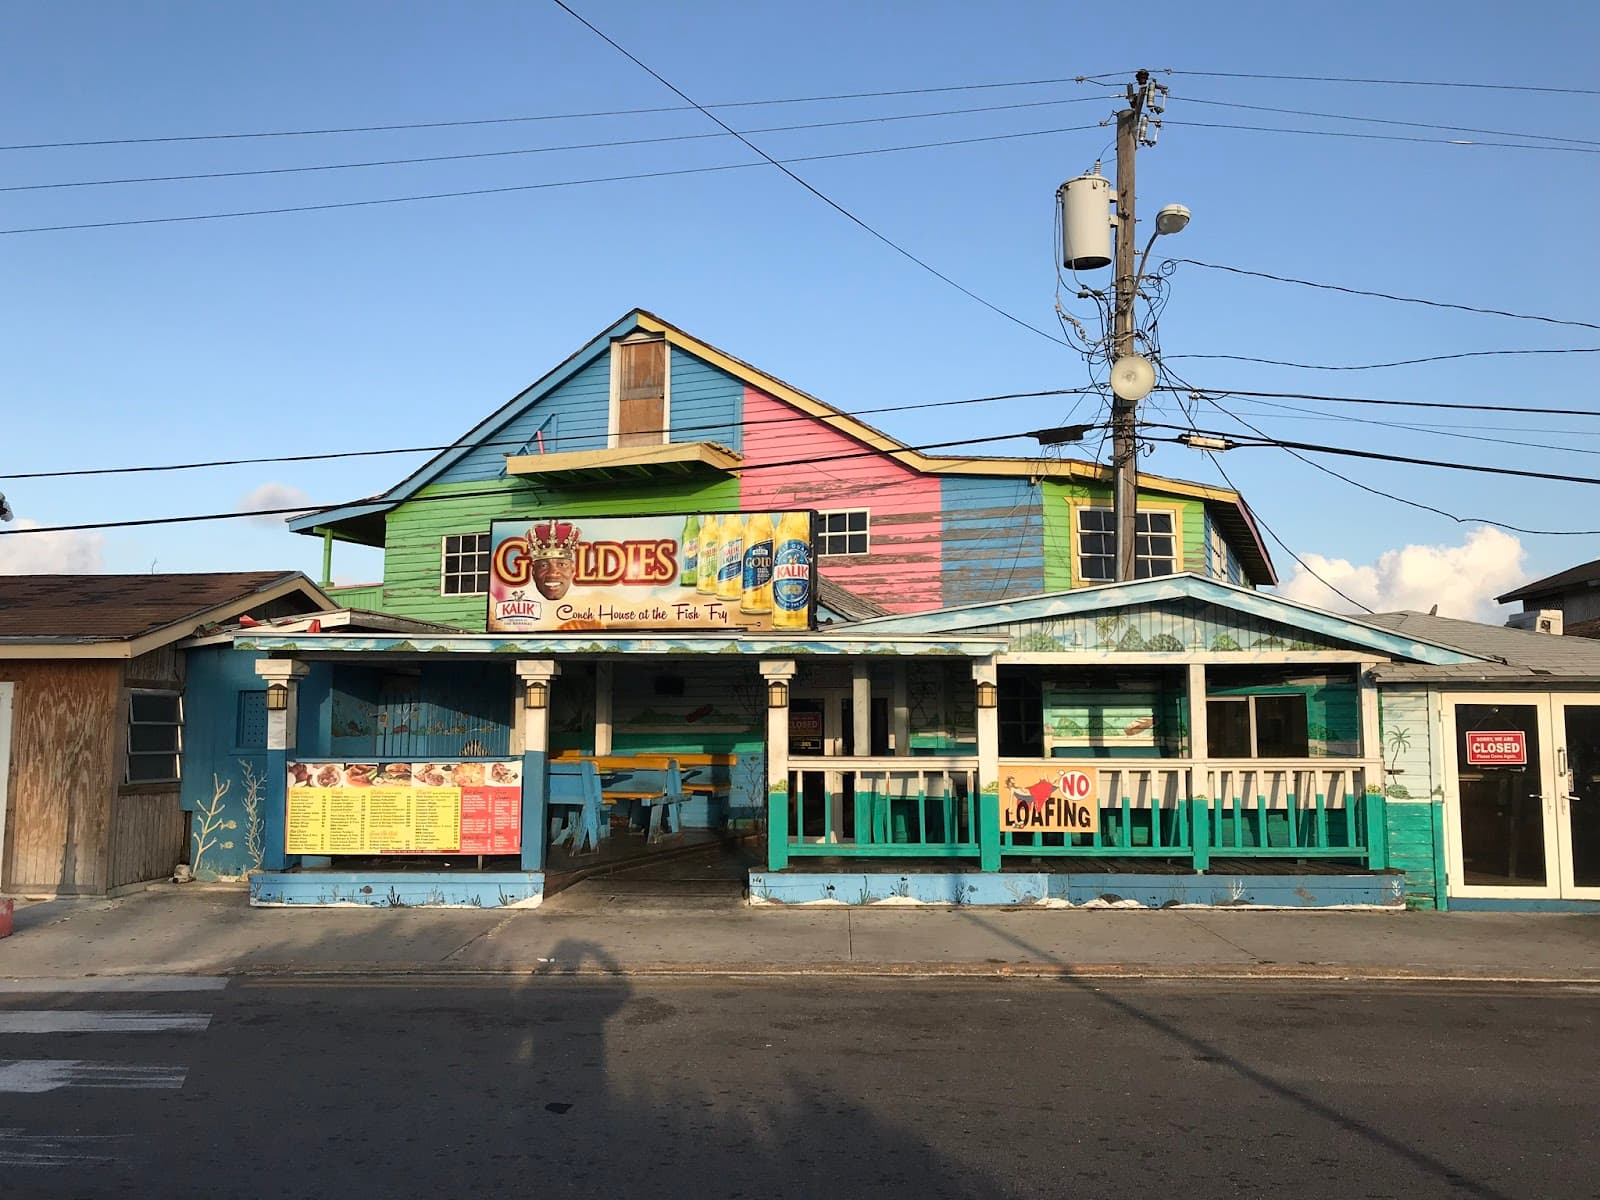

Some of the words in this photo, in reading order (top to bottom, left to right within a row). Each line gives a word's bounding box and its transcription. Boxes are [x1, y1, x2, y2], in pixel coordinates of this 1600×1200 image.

[494, 538, 680, 587] GLDIES
[746, 556, 772, 568] GOLD
[777, 564, 808, 577] KALIK
[502, 602, 535, 616] KALIK
[556, 604, 595, 621] Conch
[598, 604, 636, 621] House
[638, 608, 650, 621] at
[652, 606, 668, 621] the
[672, 603, 700, 621] Fish
[704, 602, 728, 623] Fry
[1472, 742, 1520, 753] CLOSED
[1062, 774, 1090, 797] NO
[1005, 797, 1091, 828] LOAFING
